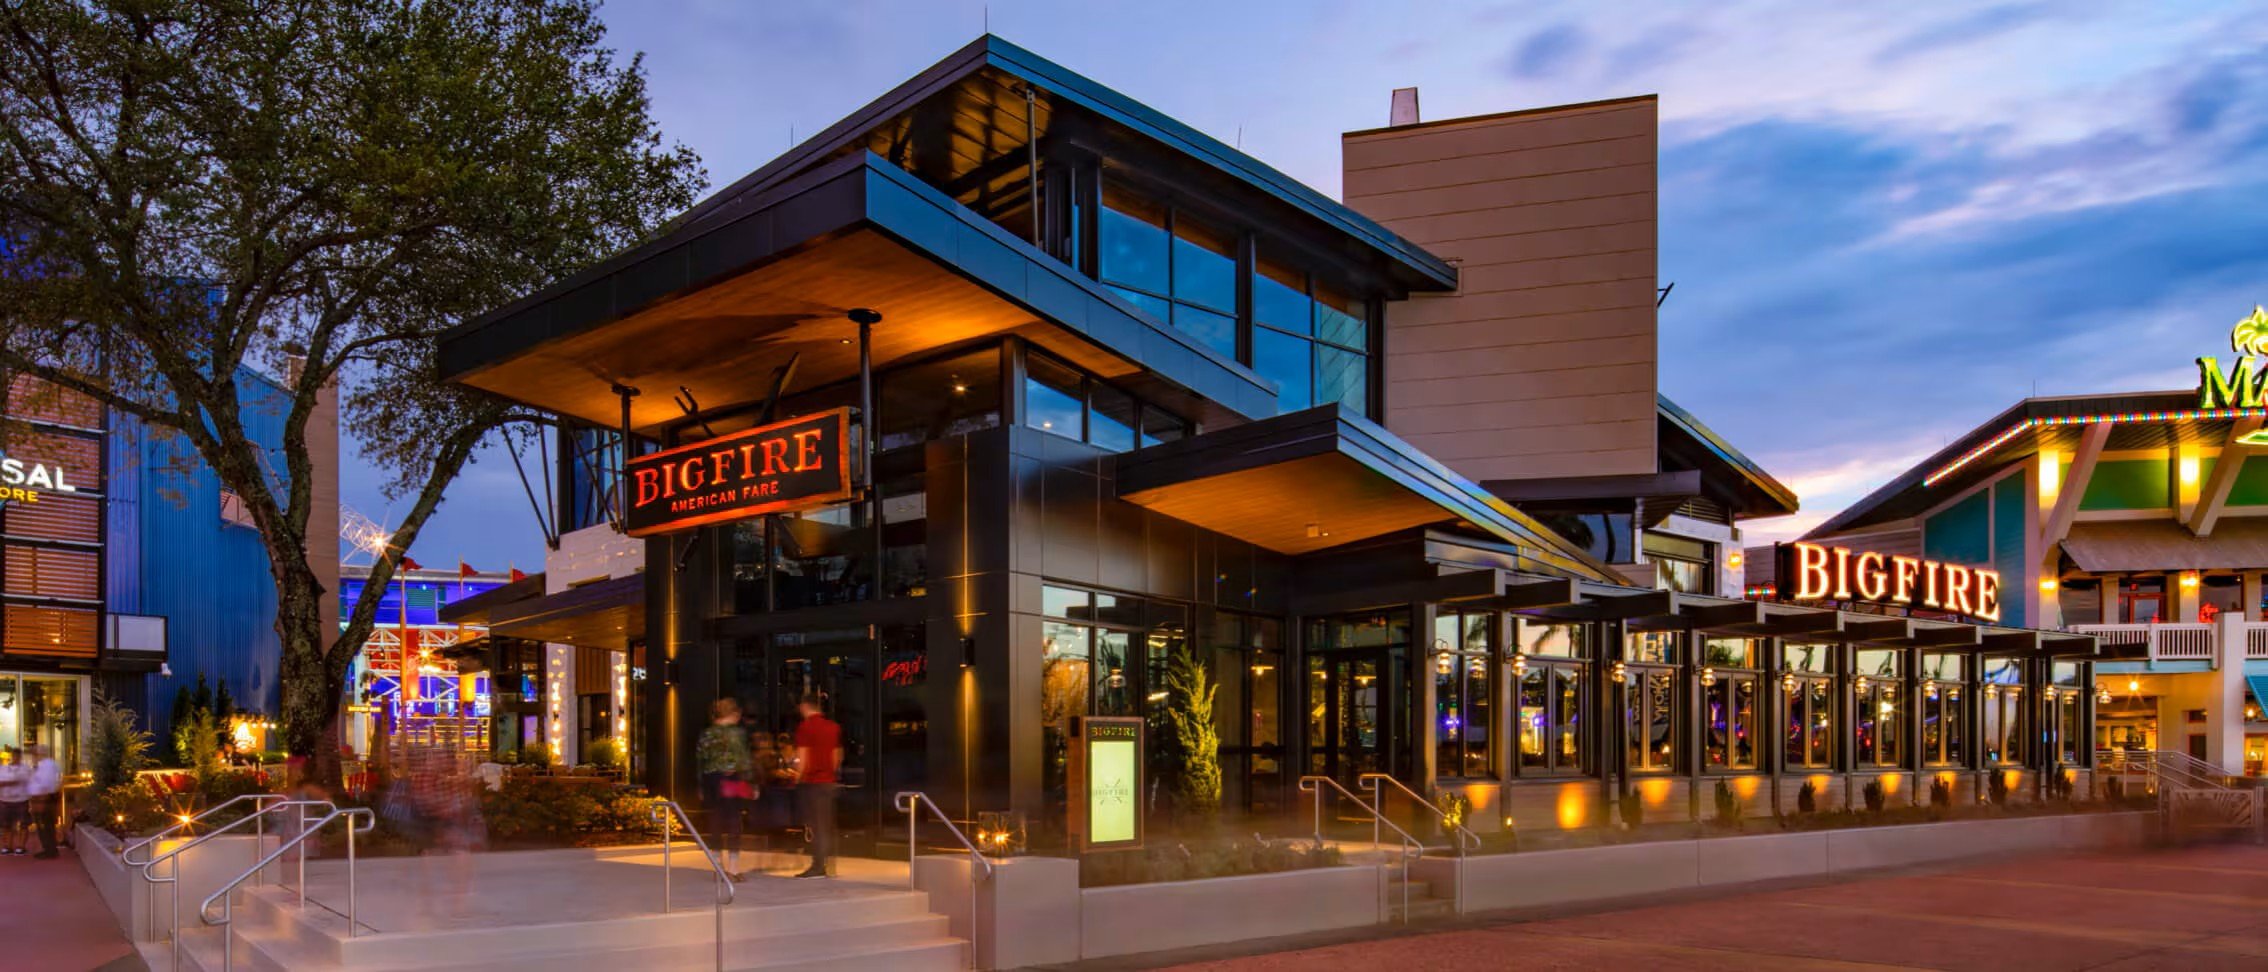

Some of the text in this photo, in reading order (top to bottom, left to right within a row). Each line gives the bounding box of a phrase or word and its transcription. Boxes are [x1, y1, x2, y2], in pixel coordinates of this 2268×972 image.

[1, 458, 76, 492] SAL
[634, 428, 822, 508] BIGFIRE
[671, 480, 780, 513] AMERICAN FARE
[1794, 541, 2000, 622] BIGFIRE
